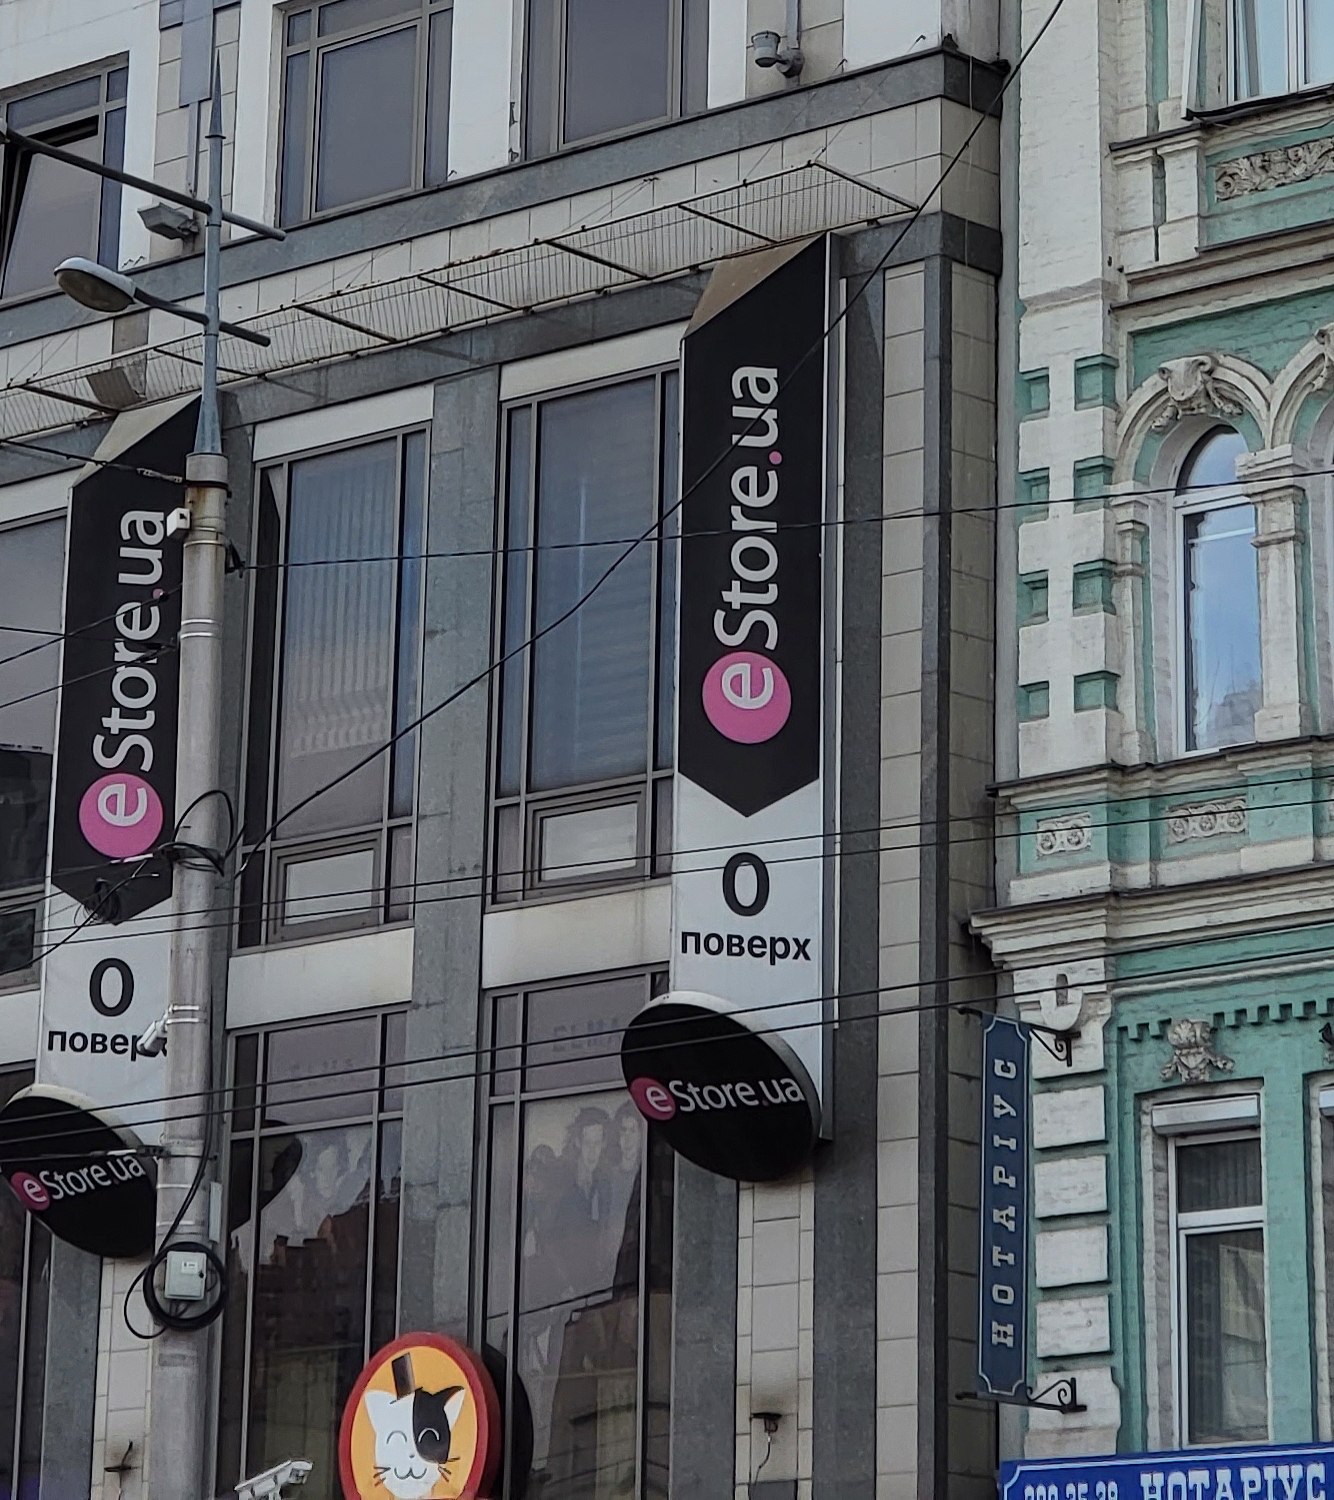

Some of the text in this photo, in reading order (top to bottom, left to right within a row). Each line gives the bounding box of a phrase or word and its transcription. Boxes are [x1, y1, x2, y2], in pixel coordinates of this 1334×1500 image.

[712, 365, 780, 711] eStore.ua
[91, 509, 166, 828] eStore.ua
[679, 926, 812, 963] поверх
[47, 1030, 167, 1062] повер
[645, 1076, 806, 1113] eStore.ua
[22, 1154, 147, 1203] eStore.ua
[990, 1055, 1017, 1349] НОТАРІУС
[1139, 1462, 1326, 1500] НОТАРІУС
